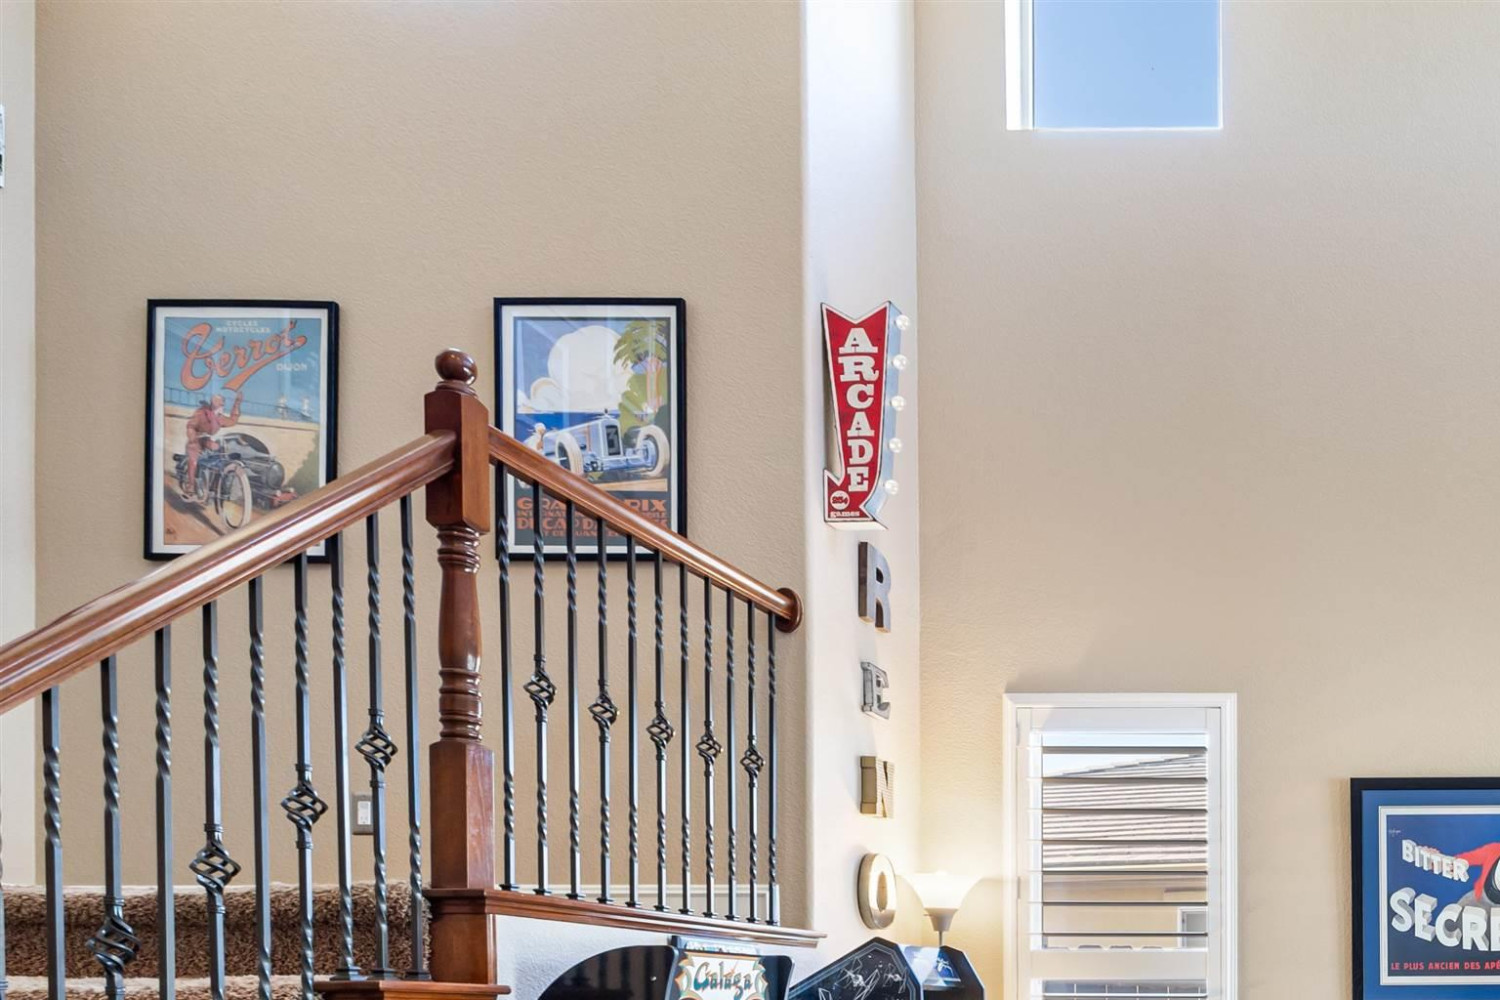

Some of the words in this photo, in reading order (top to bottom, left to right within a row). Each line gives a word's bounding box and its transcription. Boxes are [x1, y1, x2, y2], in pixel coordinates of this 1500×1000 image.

[838, 327, 880, 492] ARCADE
[1402, 839, 1470, 882] BITTER
[1391, 962, 1400, 970] LE
[1403, 962, 1424, 970] PLUS
[1428, 962, 1460, 970] ANCIEN
[1463, 962, 1481, 970] DES
